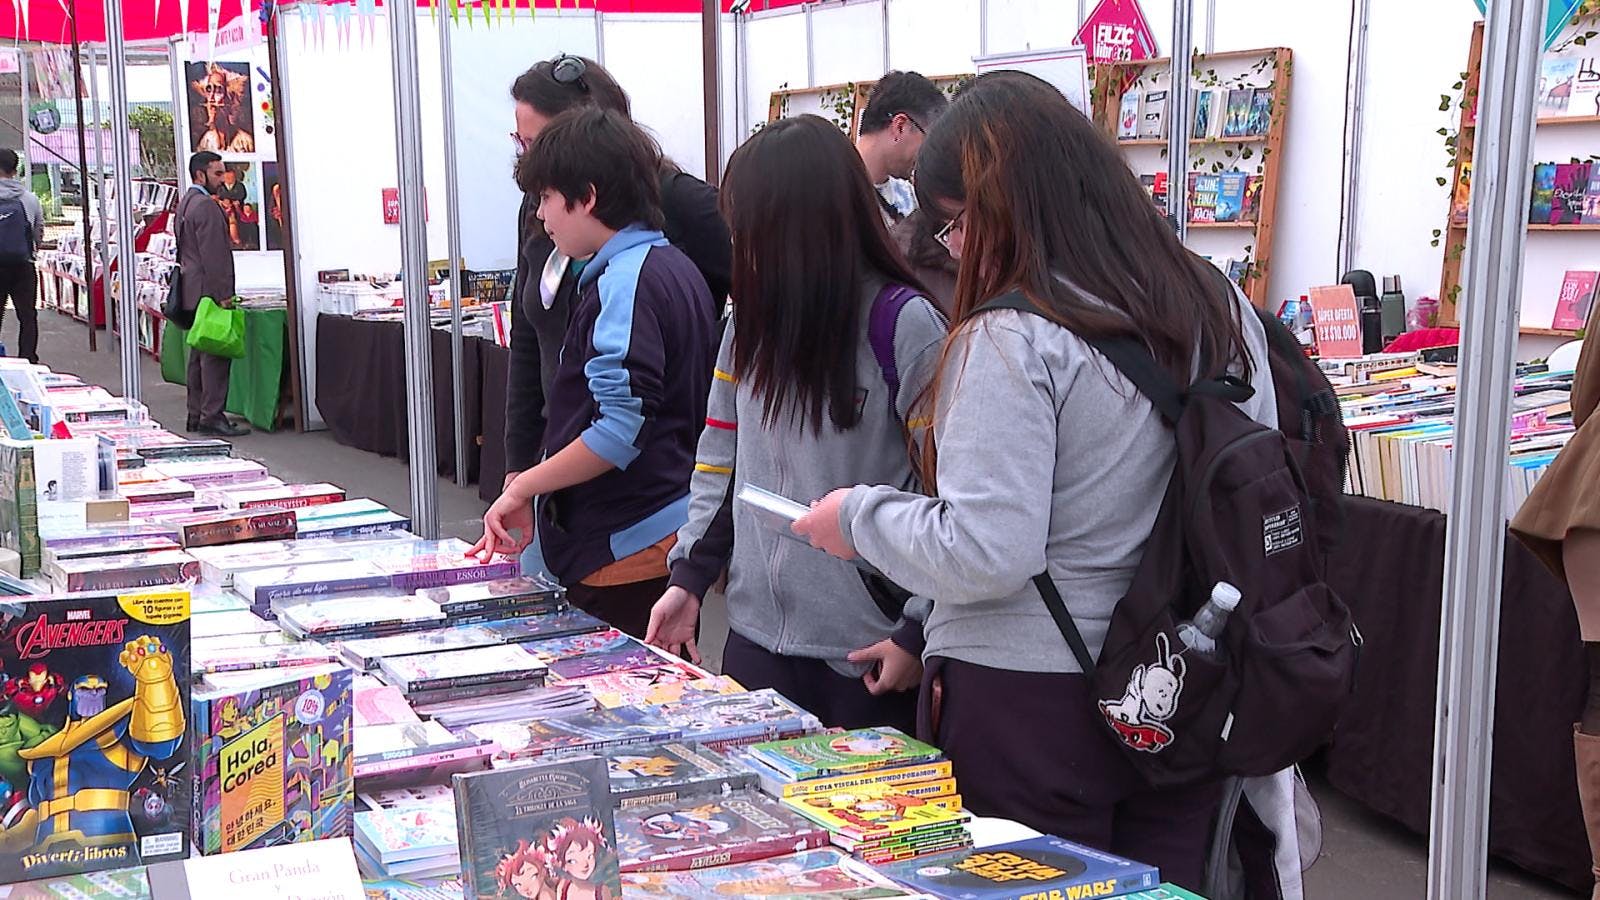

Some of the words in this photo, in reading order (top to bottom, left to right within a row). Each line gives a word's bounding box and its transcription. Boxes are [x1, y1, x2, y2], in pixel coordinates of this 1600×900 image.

[1334, 307, 1355, 321] OFERTA
[456, 570, 487, 580] ESNOB
[66, 610, 91, 620] MARVEL
[143, 605, 153, 614] 10
[16, 613, 129, 659] AVENGERS
[302, 698, 318, 713] 10%
[227, 737, 272, 773] Hola,
[223, 753, 277, 793] Corea
[834, 779, 859, 789] VISUAL
[860, 777, 873, 786] DEL
[874, 774, 901, 783] MUNDO
[274, 859, 321, 878] Panda
[1019, 889, 1065, 900] STAR
[1065, 879, 1117, 900] WARS
